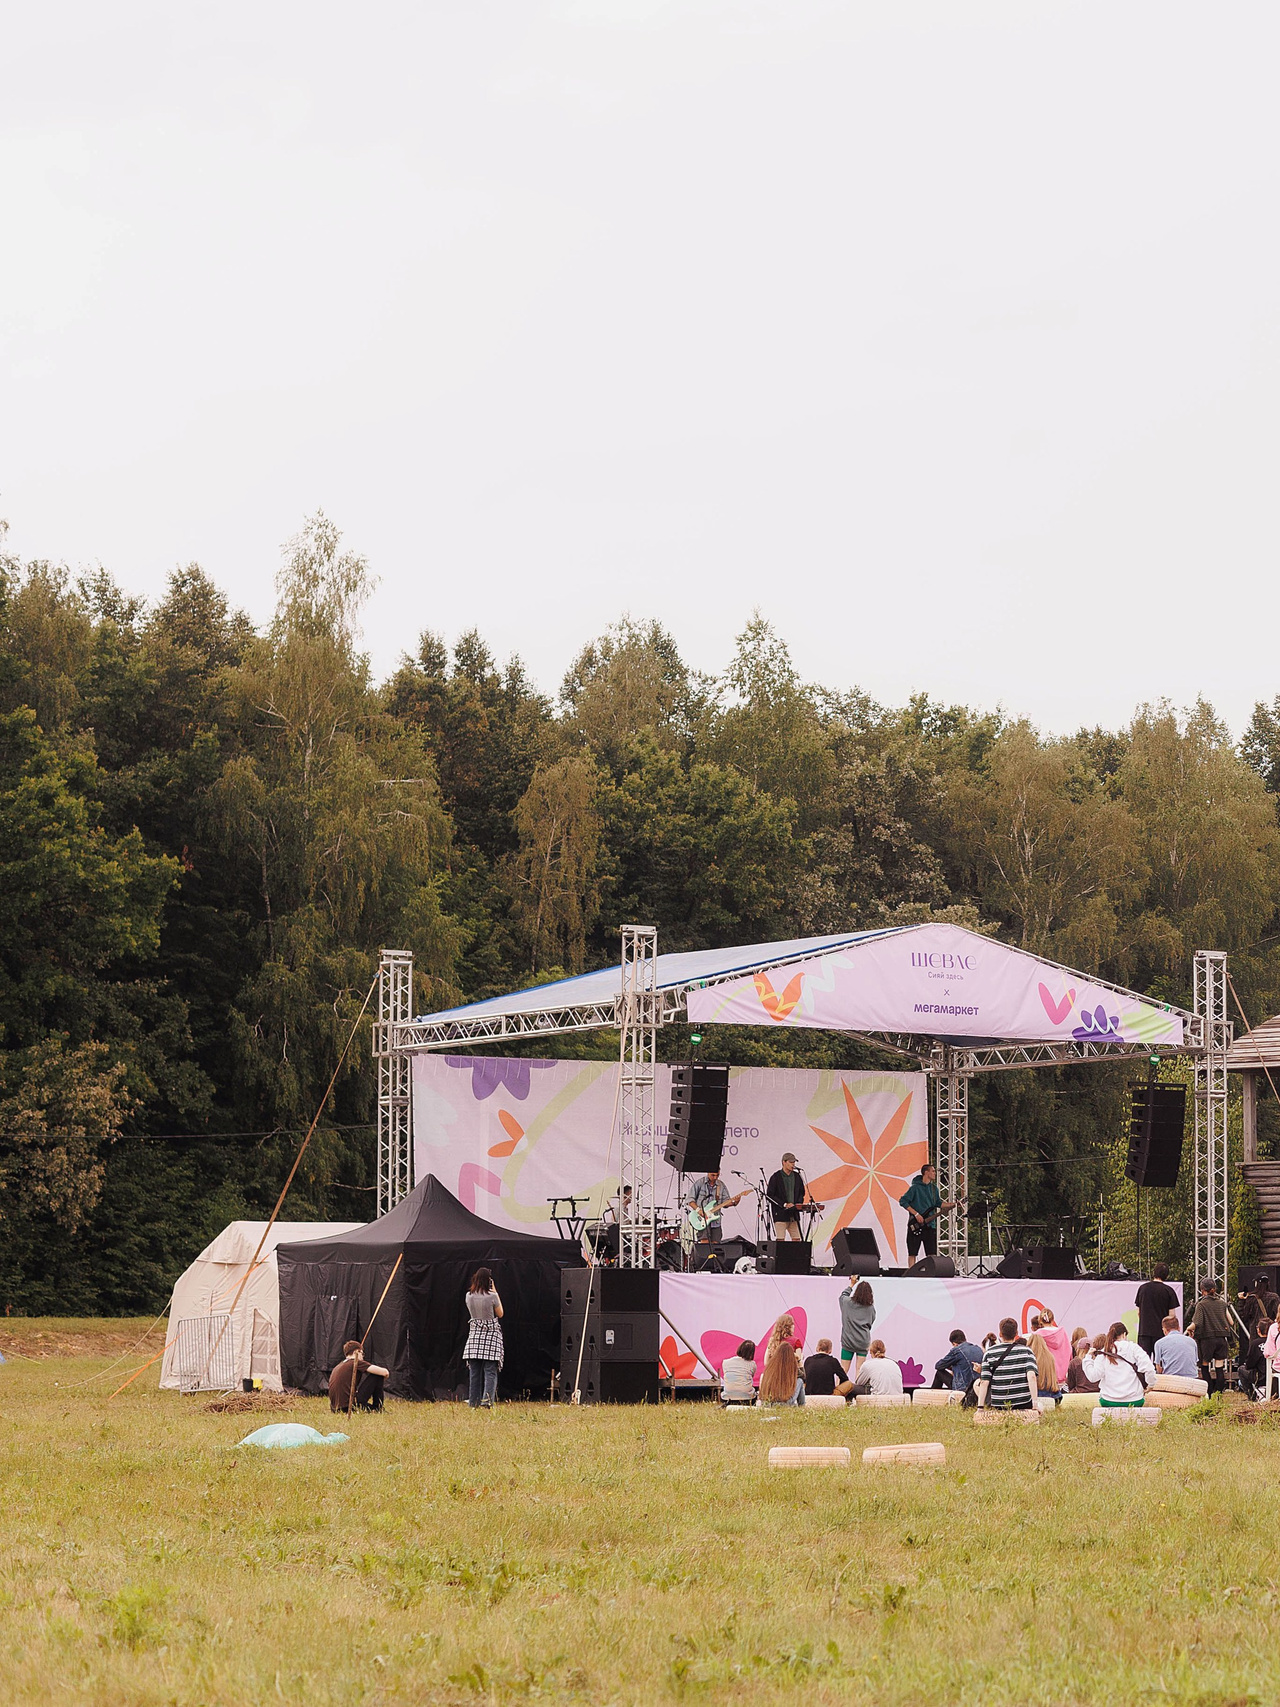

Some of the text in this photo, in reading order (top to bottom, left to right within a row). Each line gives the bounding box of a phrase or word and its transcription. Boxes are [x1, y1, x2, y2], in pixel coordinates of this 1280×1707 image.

[928, 971, 945, 979] Сияй
[914, 1004, 979, 1016] мегамаркет
[723, 1126, 759, 1138] лето
